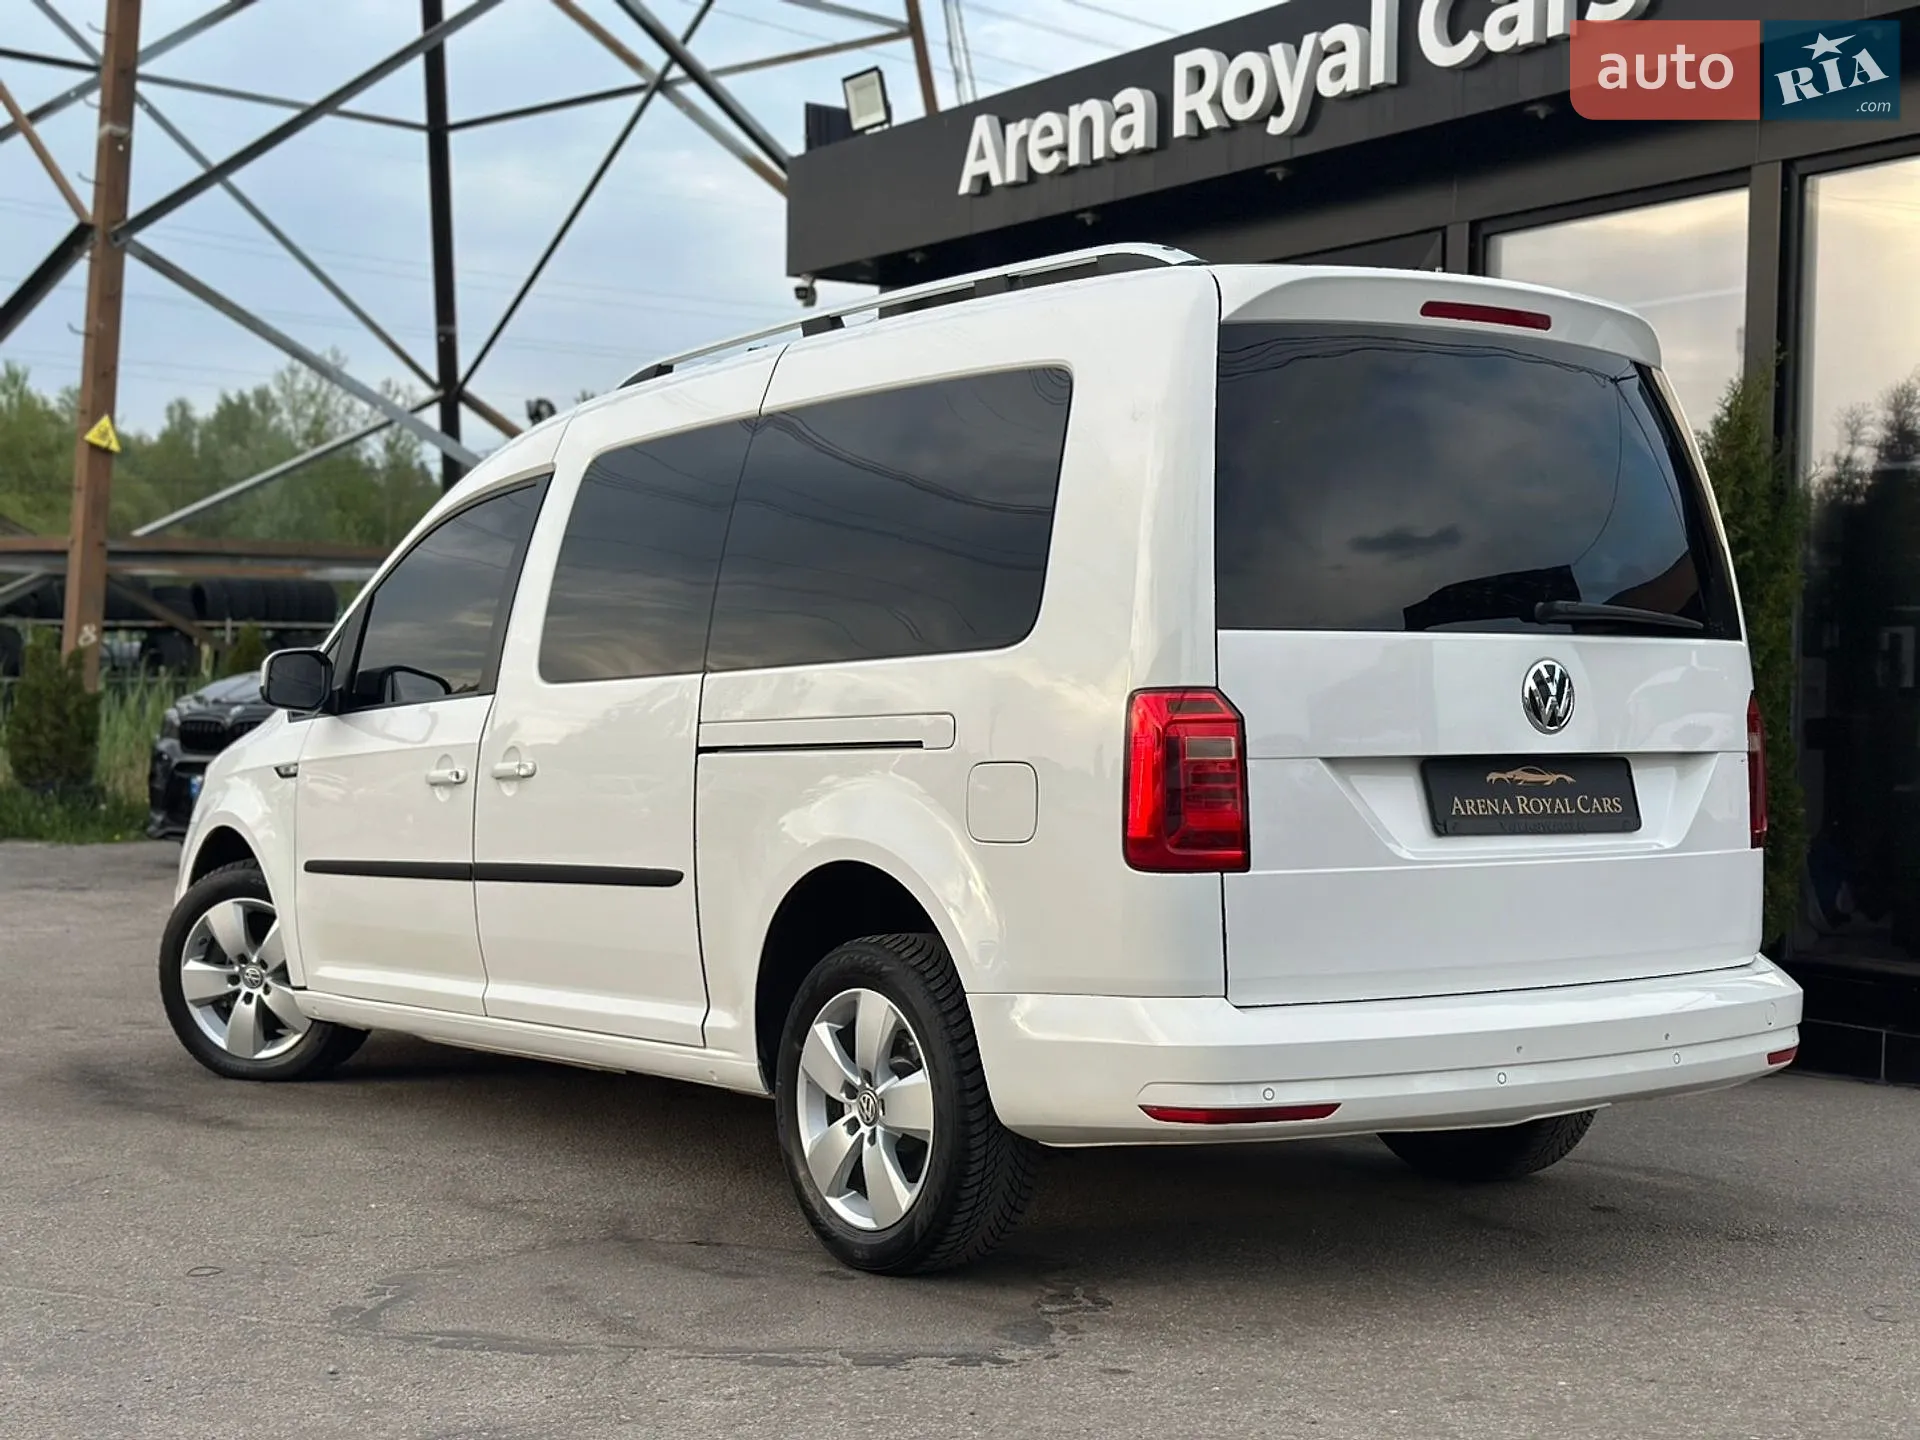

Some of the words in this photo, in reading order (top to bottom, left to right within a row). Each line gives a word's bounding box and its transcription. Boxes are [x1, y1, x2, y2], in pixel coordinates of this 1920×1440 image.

[958, 87, 1157, 195] Arena
[1173, 0, 1398, 137] Royal
[1418, 0, 1648, 68] Ca
[1451, 796, 1514, 816] ARENA
[1515, 795, 1576, 815] ROYAL
[1577, 795, 1623, 814] CARS
